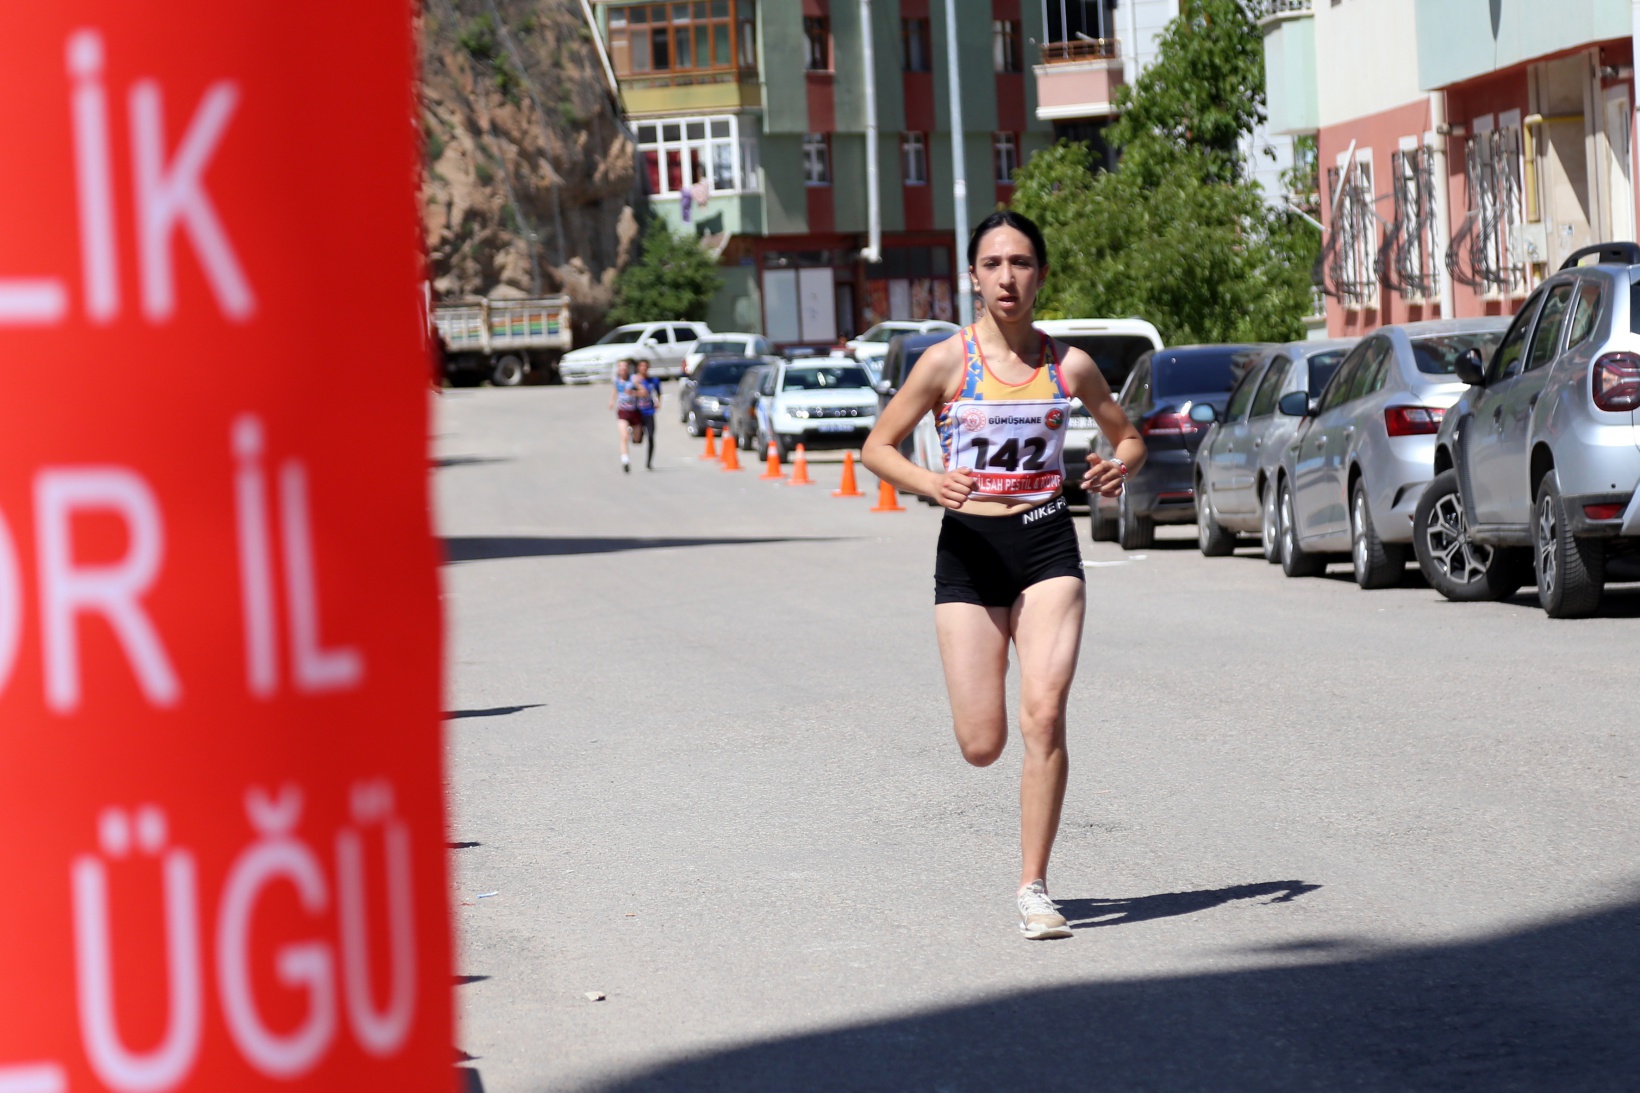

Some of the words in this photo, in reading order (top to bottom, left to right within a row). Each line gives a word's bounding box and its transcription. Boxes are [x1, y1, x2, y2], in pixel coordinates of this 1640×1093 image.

[988, 415, 1042, 426] GÜMÜŞHANE
[971, 436, 1048, 472] 142
[1022, 502, 1056, 525] NIKE
[0, 466, 181, 714] R
[232, 413, 363, 697] İL
